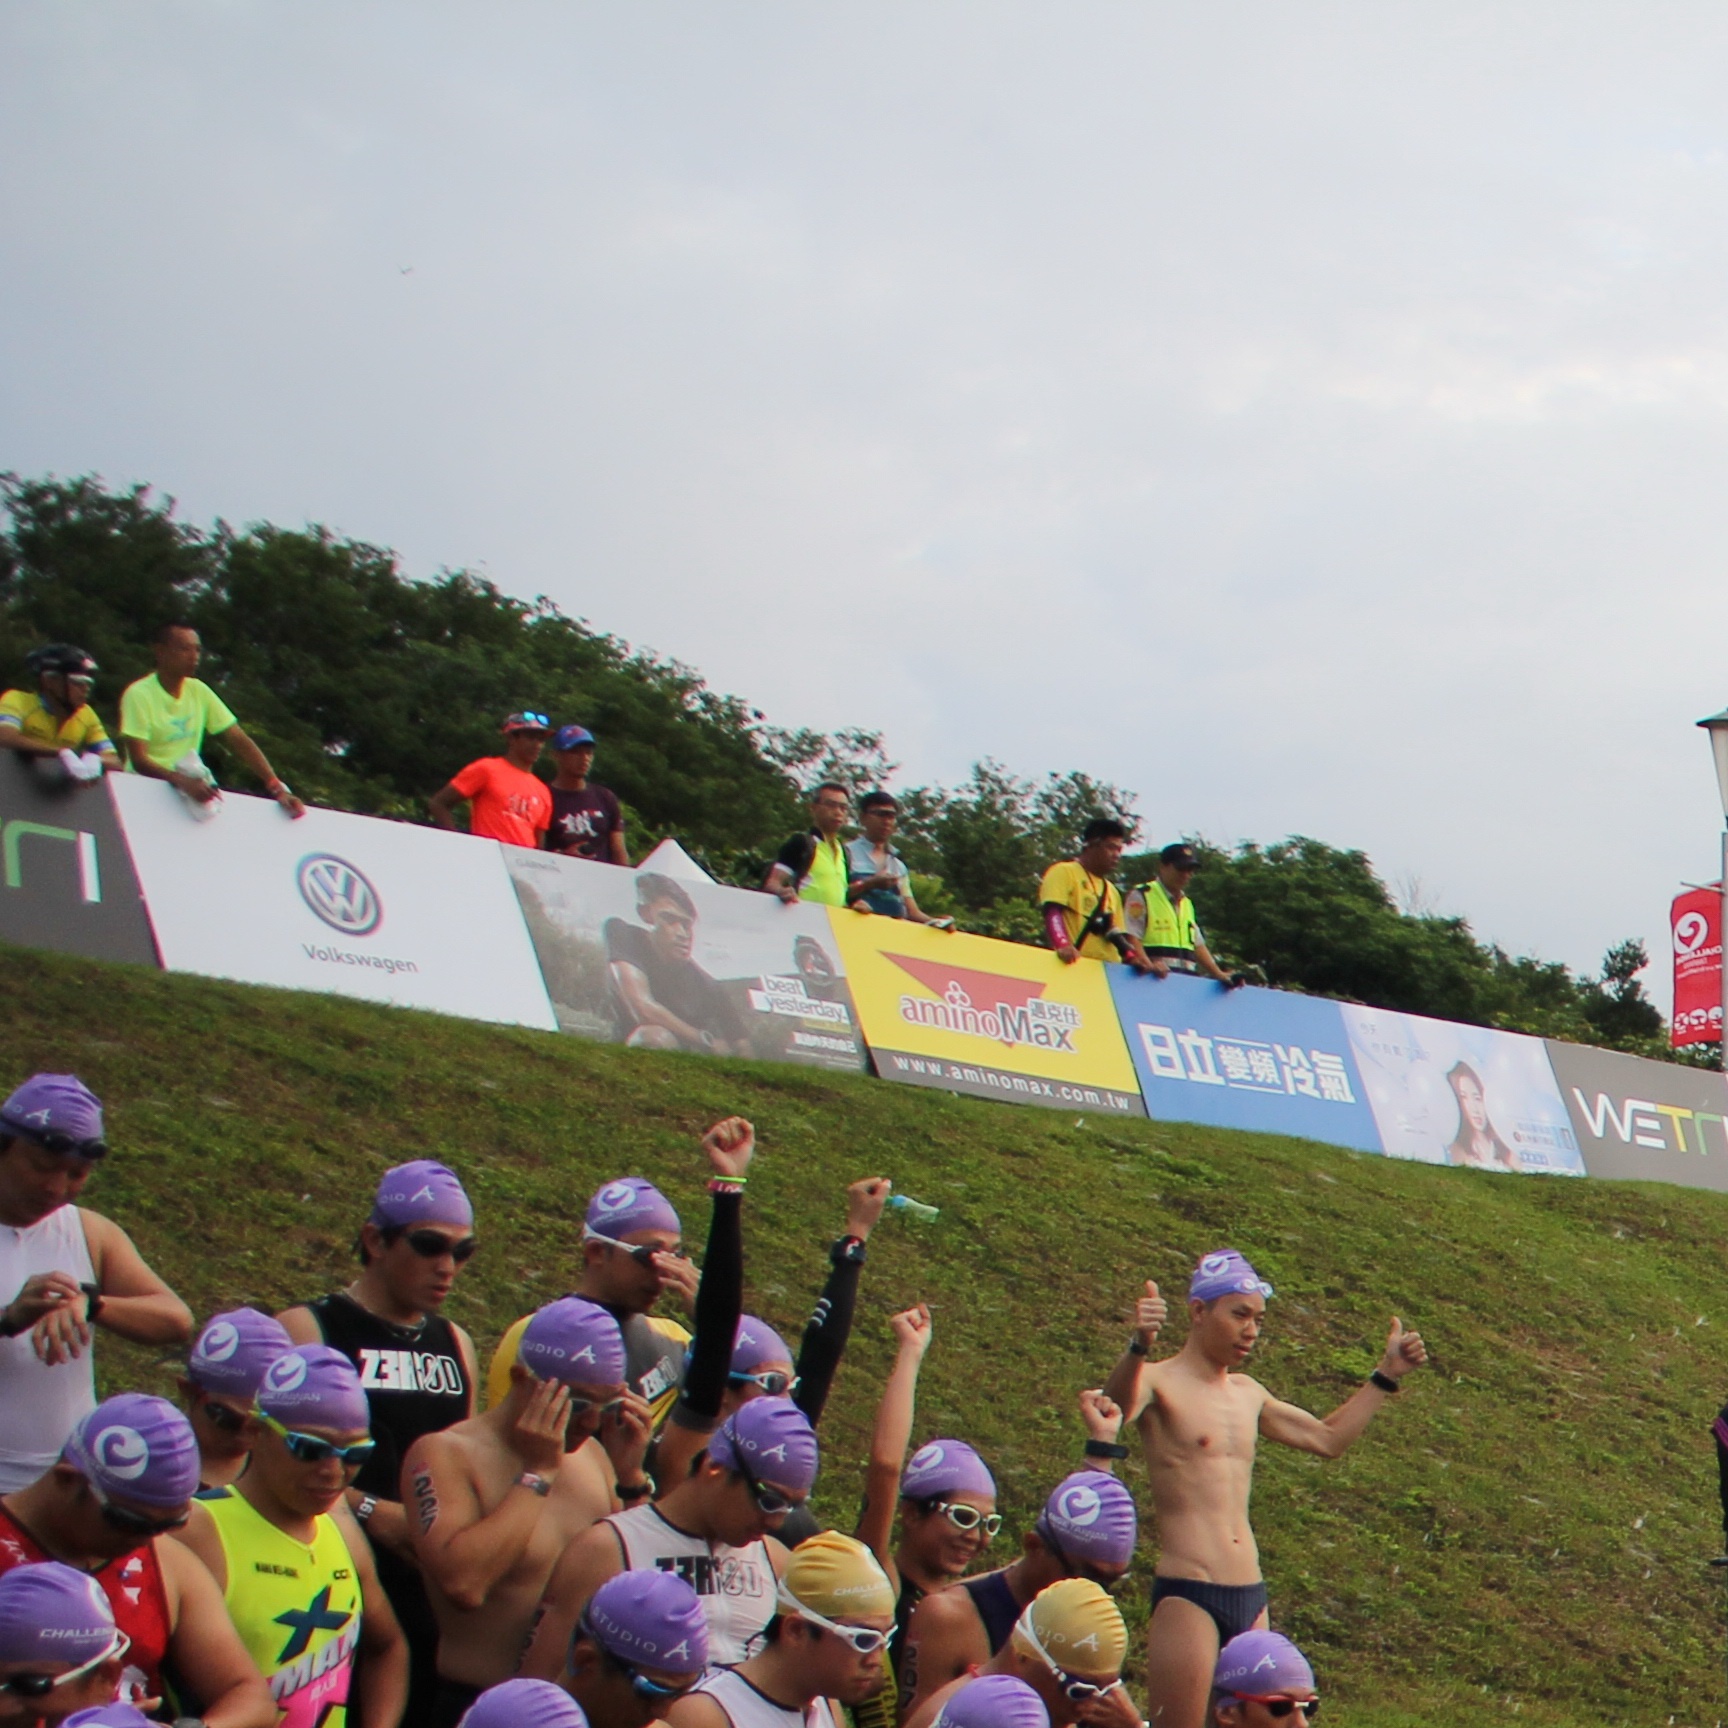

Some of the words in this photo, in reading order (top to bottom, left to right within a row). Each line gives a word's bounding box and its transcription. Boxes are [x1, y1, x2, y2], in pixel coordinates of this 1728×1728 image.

[302, 943, 419, 974] Volkswagen
[766, 978, 803, 996] beat
[901, 992, 1076, 1052] aminoMax
[1138, 1022, 1356, 1103] 日立變頻冷氣
[893, 1055, 1129, 1110] www.aminomax.com.tw
[410, 1184, 436, 1203] A
[735, 1330, 757, 1351] A
[570, 1343, 597, 1365] A
[761, 1442, 788, 1463] A
[662, 1638, 691, 1662] A
[1071, 1632, 1100, 1654] A
[1252, 1653, 1278, 1674] A
